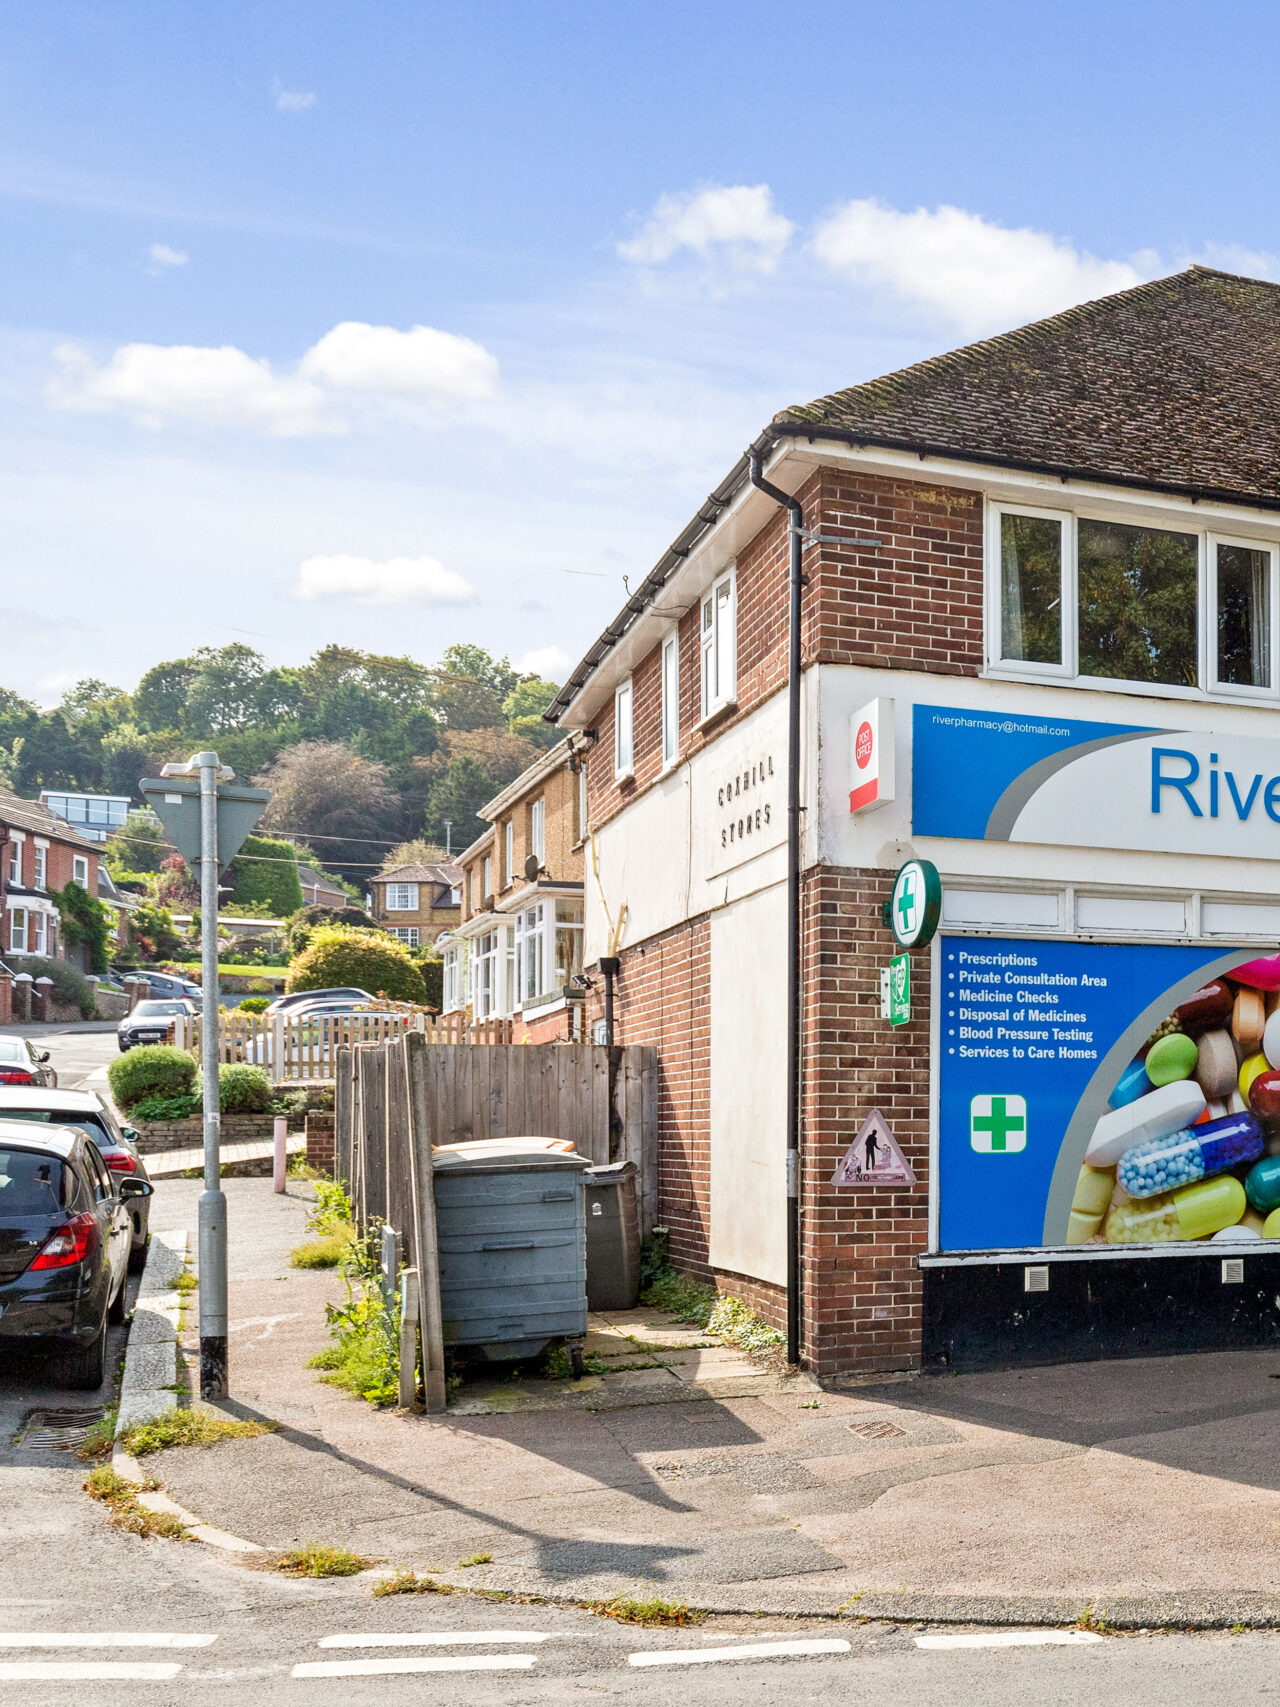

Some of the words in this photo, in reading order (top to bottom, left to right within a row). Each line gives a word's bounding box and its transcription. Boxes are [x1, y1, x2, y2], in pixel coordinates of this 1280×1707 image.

[932, 715, 1070, 737] riverpharmacy@hotmail.com
[859, 729, 870, 745] POST
[857, 742, 871, 760] OFFICE
[721, 803, 771, 848] STORES
[959, 951, 1038, 967] Prescriptions
[959, 970, 1001, 984] Private
[1004, 971, 1078, 986] Consultation
[1081, 974, 1107, 987] Area
[959, 989, 1013, 1003] Medicine
[1016, 990, 1059, 1004] Checks
[959, 1008, 1009, 1023] Disposal
[1012, 1009, 1025, 1022] of
[1028, 1009, 1087, 1023] Medicines
[959, 1026, 993, 1039] Blood
[997, 1027, 1049, 1040] Pressure
[1052, 1028, 1093, 1043] Testing
[959, 1045, 1009, 1058] Services
[1012, 1046, 1025, 1058] to
[1028, 1046, 1055, 1059] Care
[1058, 1046, 1097, 1059] Homes
